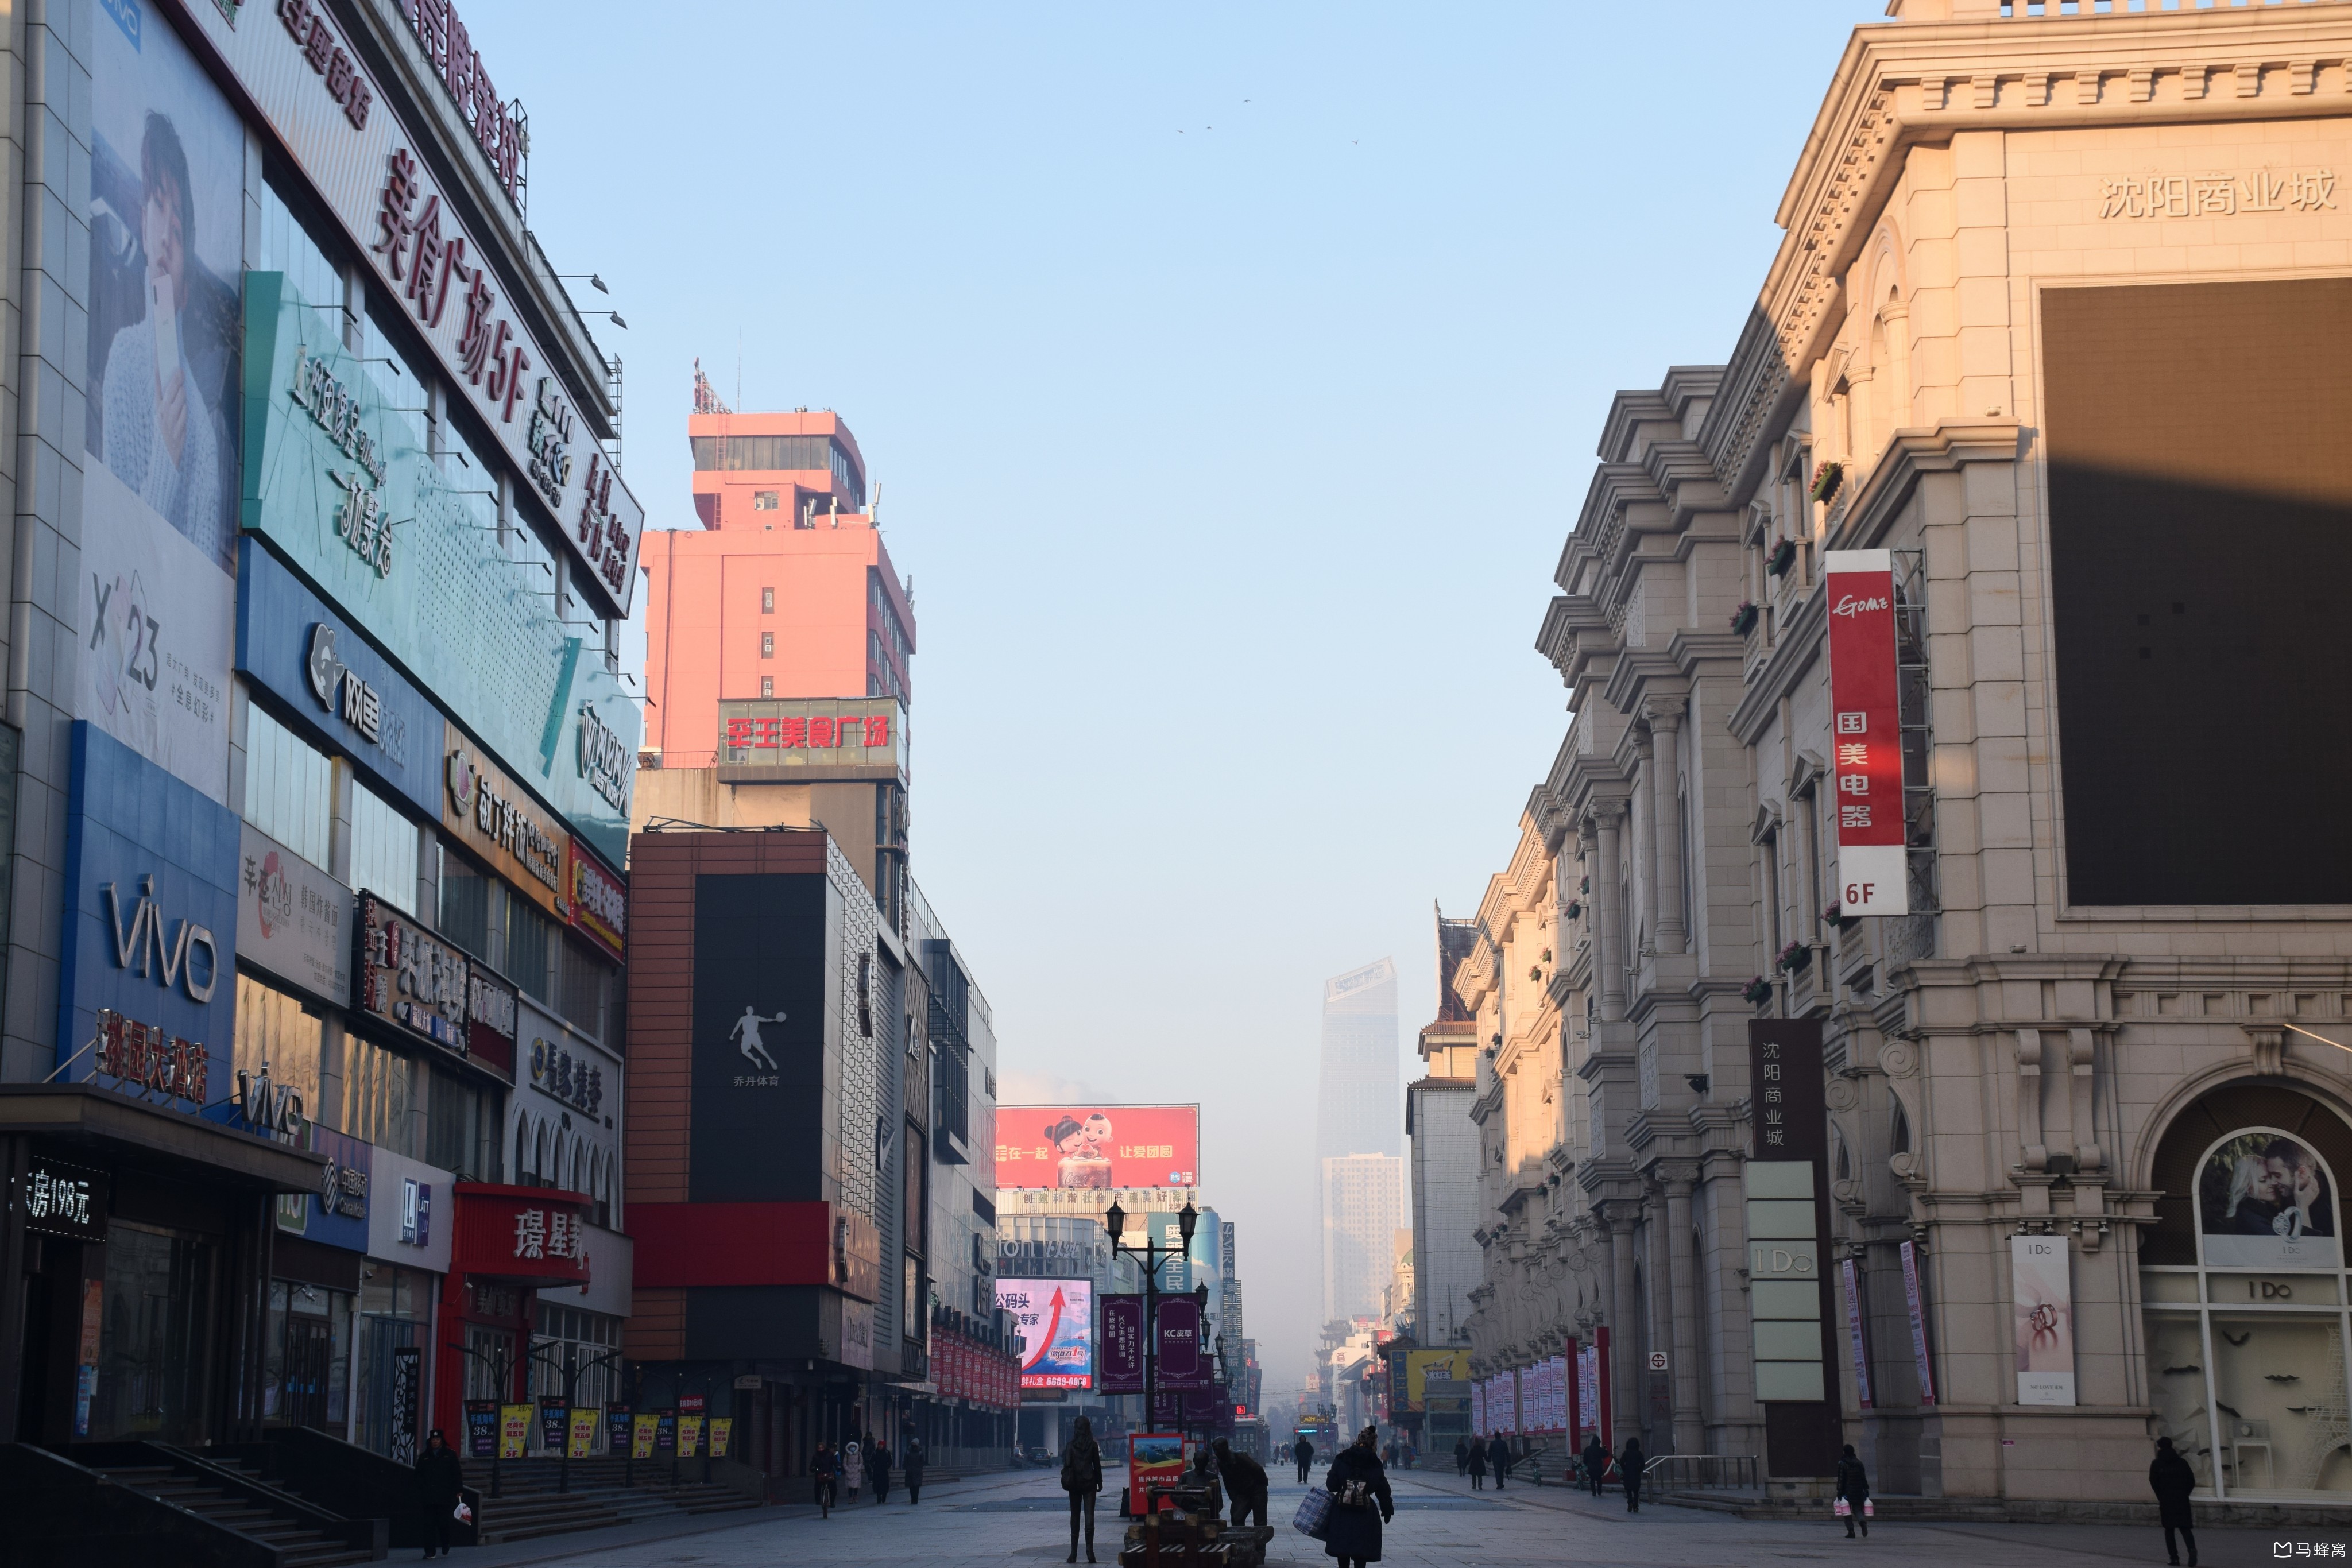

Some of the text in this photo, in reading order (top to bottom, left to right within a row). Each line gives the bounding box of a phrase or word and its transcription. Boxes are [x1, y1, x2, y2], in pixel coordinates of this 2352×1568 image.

[2099, 169, 2337, 218] 沈阳商业城
[374, 148, 531, 423] 美食广场5F
[331, 468, 392, 579] 一场聚会
[727, 715, 888, 748] 罕王美食广场
[1838, 712, 1872, 828] 国美电器
[1845, 882, 1875, 904] 6F
[108, 873, 218, 1003] vivo
[733, 1075, 780, 1087] 乔丹体育
[1763, 1042, 1784, 1146] 沈阳商业城
[1119, 1145, 1173, 1159] 让爱团圆
[341, 1168, 369, 1198] 中国移动
[1023, 1192, 1106, 1205] 创建和谐社会
[1165, 1225, 1184, 1291] 奥新全民
[1755, 1249, 1764, 1273] I
[2249, 1281, 2254, 1298] I
[1021, 1377, 1044, 1385] 鲜礼盒
[474, 1426, 488, 1436] 38
[545, 1420, 558, 1428] 38
[612, 1423, 624, 1432] 38
